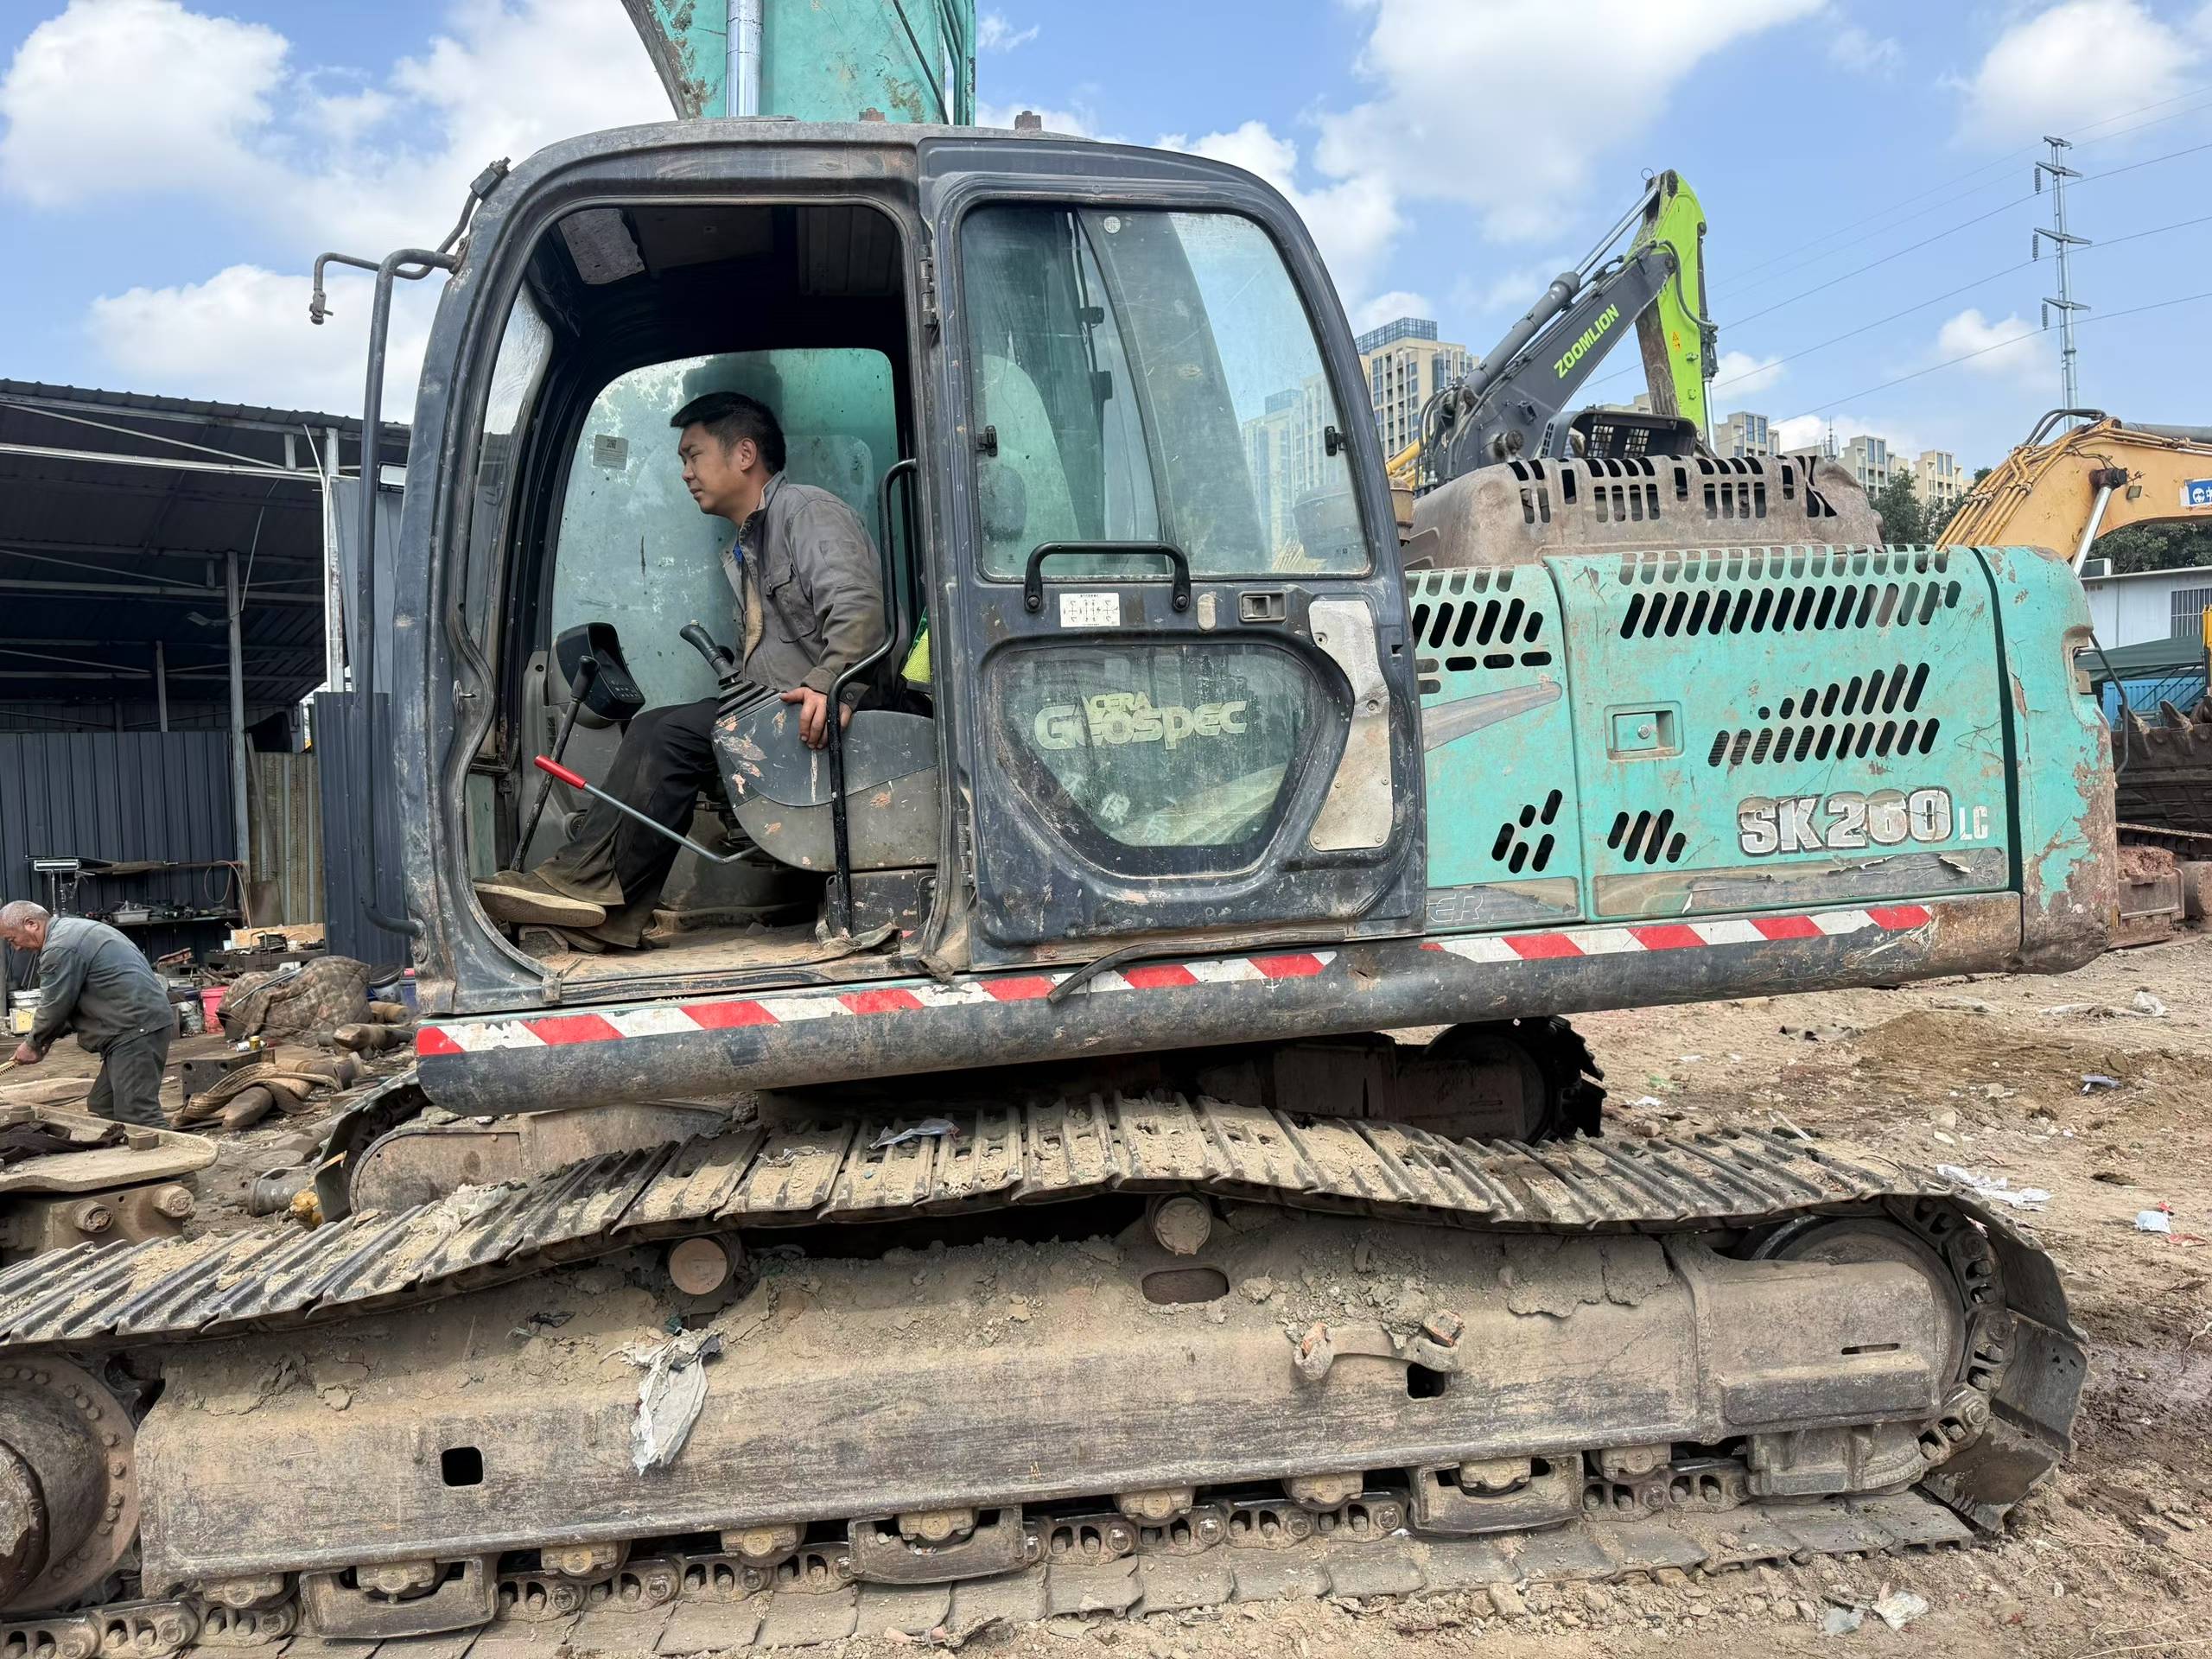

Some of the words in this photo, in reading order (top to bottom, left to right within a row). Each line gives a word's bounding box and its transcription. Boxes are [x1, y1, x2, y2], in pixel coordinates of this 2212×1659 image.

[1554, 303, 1620, 378] ZOOMLION
[1959, 805, 1988, 841] LC
[1426, 893, 1484, 922] ER
